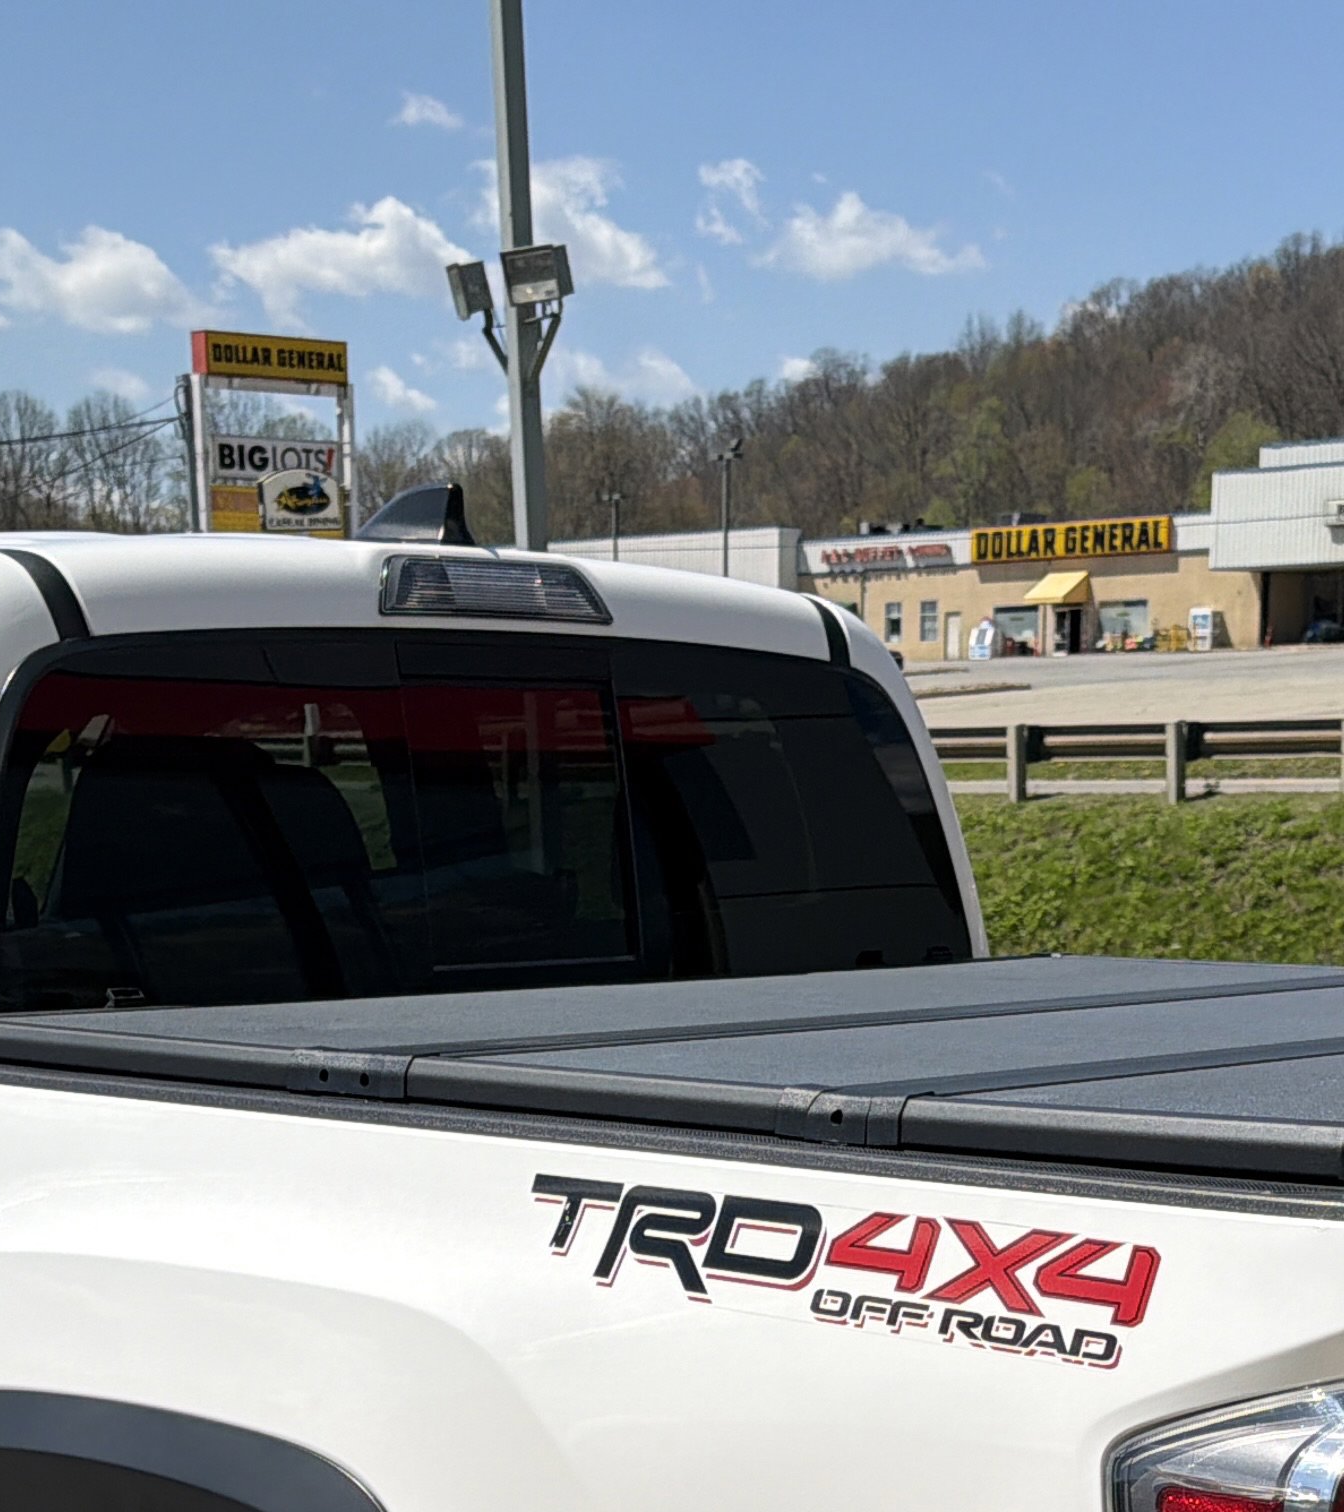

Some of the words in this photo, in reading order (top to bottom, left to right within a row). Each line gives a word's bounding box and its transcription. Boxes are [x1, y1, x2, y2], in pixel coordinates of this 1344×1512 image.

[212, 343, 272, 367] DOLLAR
[276, 348, 344, 372] GENERAL
[976, 527, 1056, 560] DOLLAR
[1065, 520, 1163, 555] GENERAL
[531, 1173, 828, 1304] TRD
[810, 1288, 941, 1336] OFF
[939, 1306, 1123, 1370] ROAD
